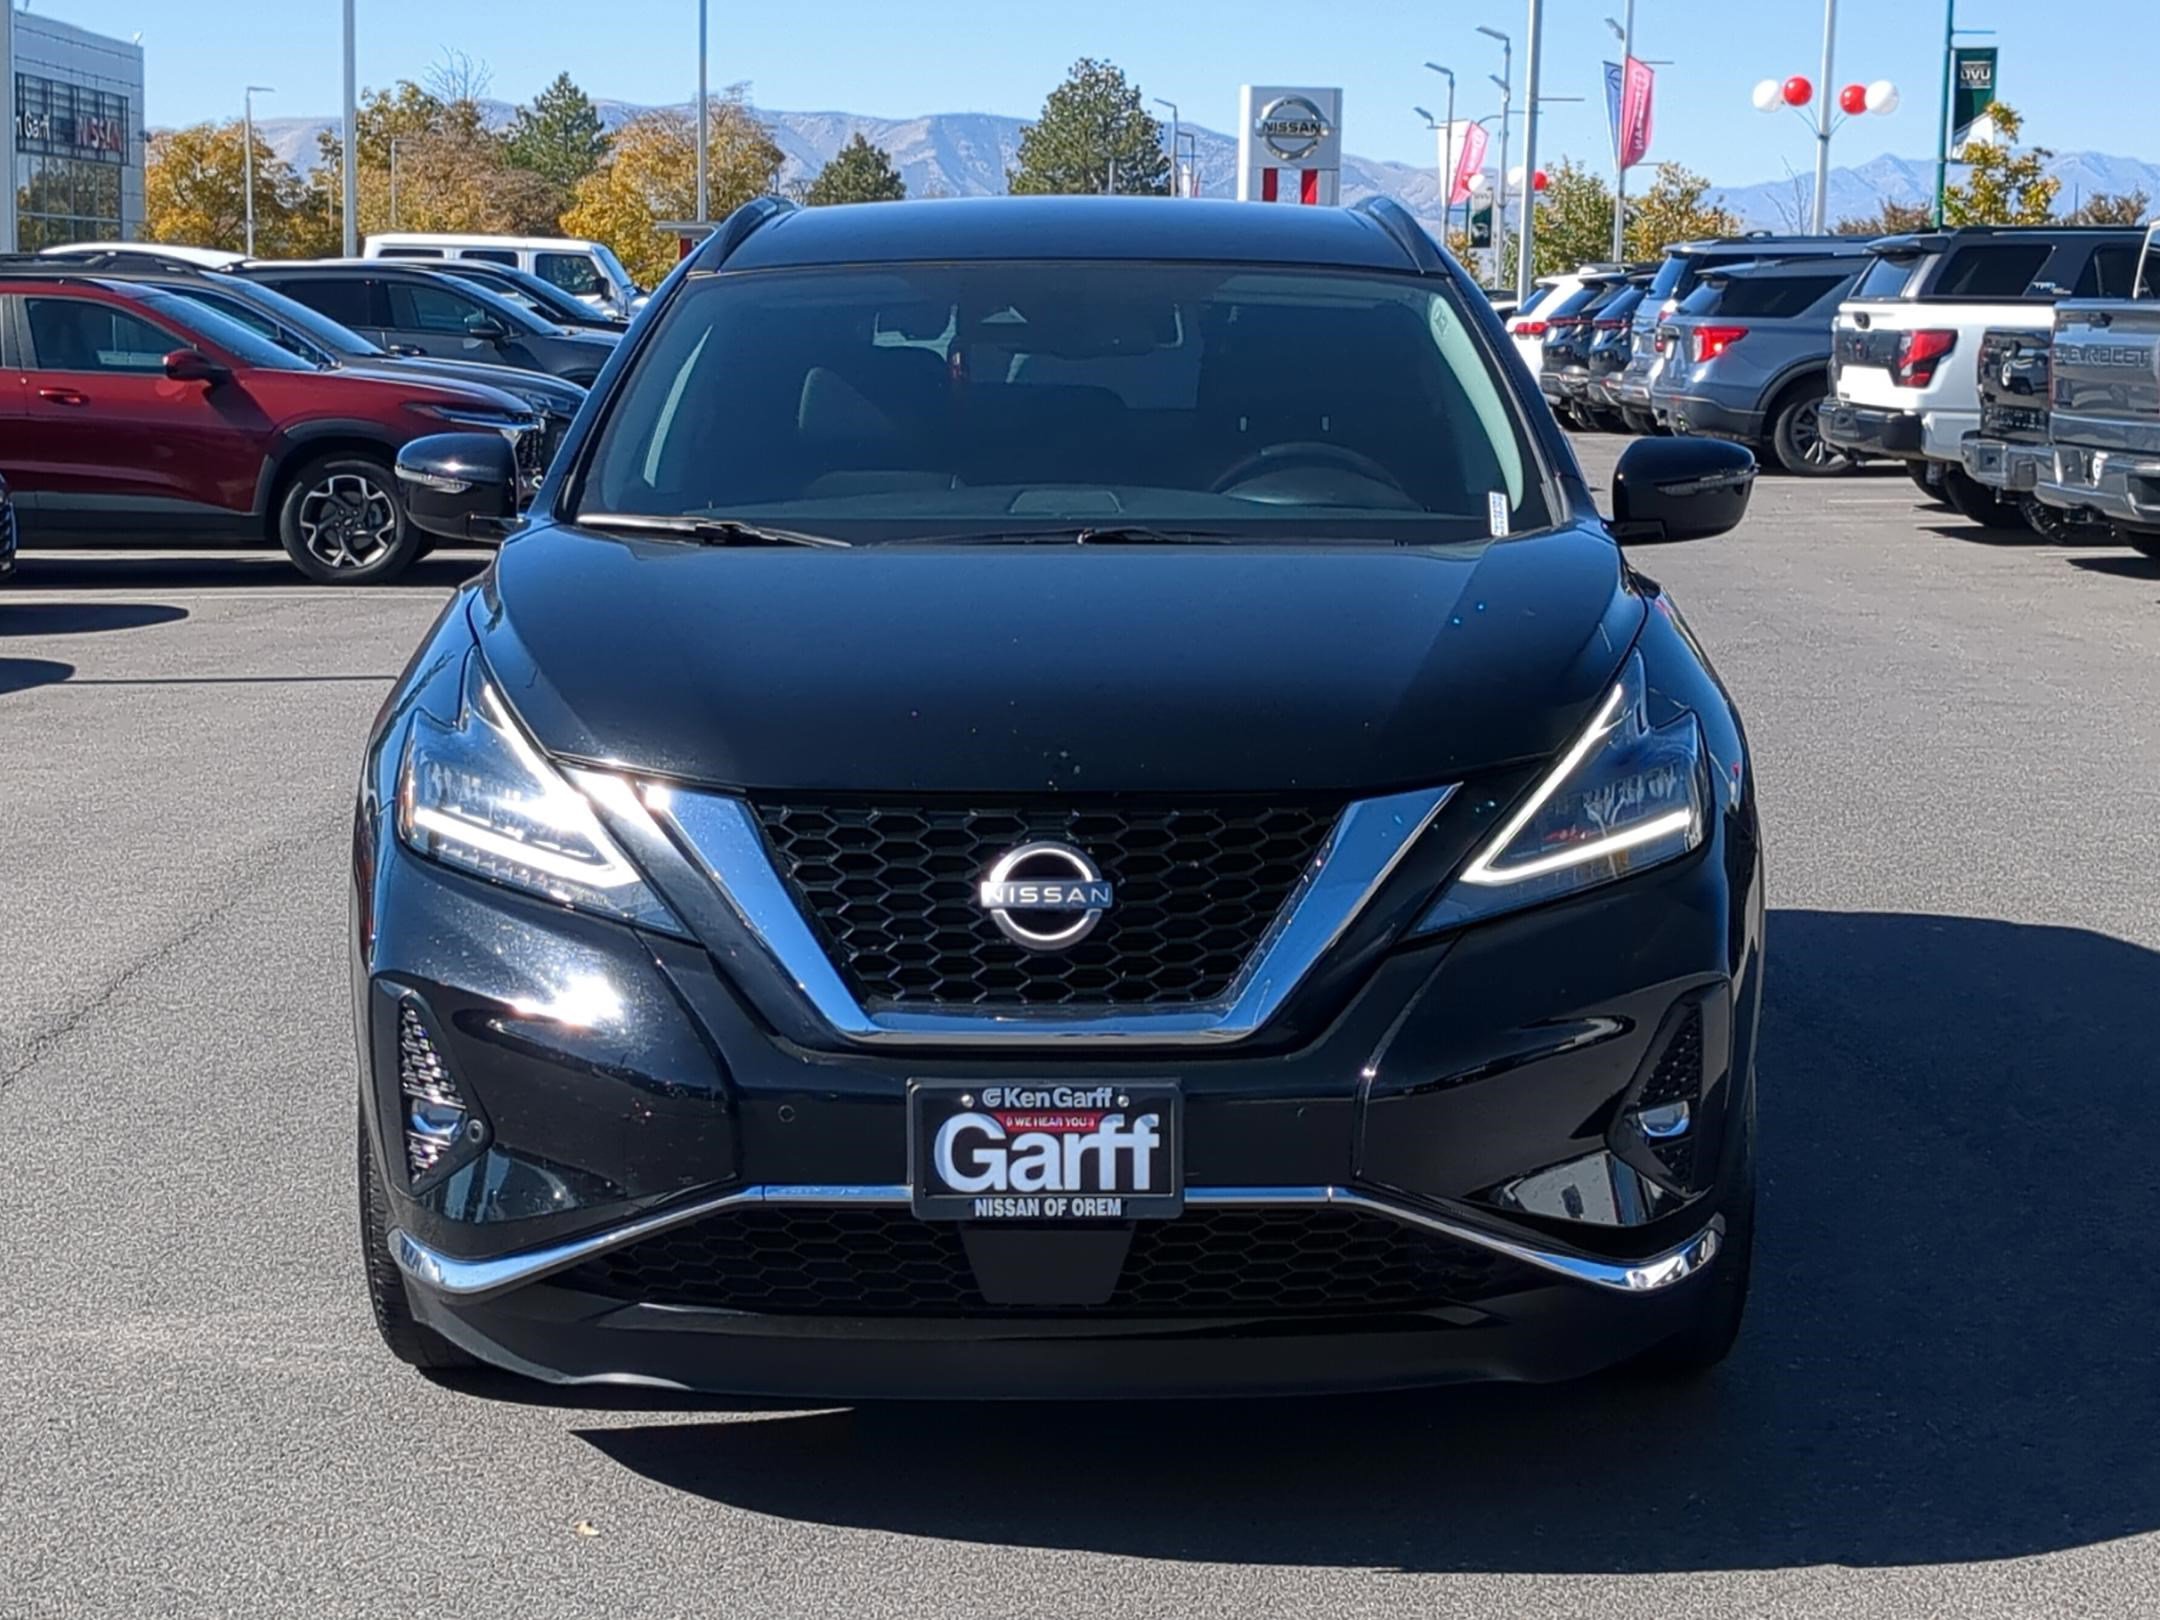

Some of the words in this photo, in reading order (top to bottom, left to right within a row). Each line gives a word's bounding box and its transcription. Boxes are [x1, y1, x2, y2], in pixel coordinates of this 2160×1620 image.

[1262, 121, 1321, 134] NISSAN
[989, 886, 1109, 903] NISSAN
[1004, 1088, 1051, 1108] Ken
[1053, 1087, 1113, 1108] Garff
[934, 1112, 1160, 1193] Garff
[975, 1198, 1039, 1217] NISSAN
[1044, 1198, 1067, 1217] OF
[1072, 1198, 1121, 1217] OREM
